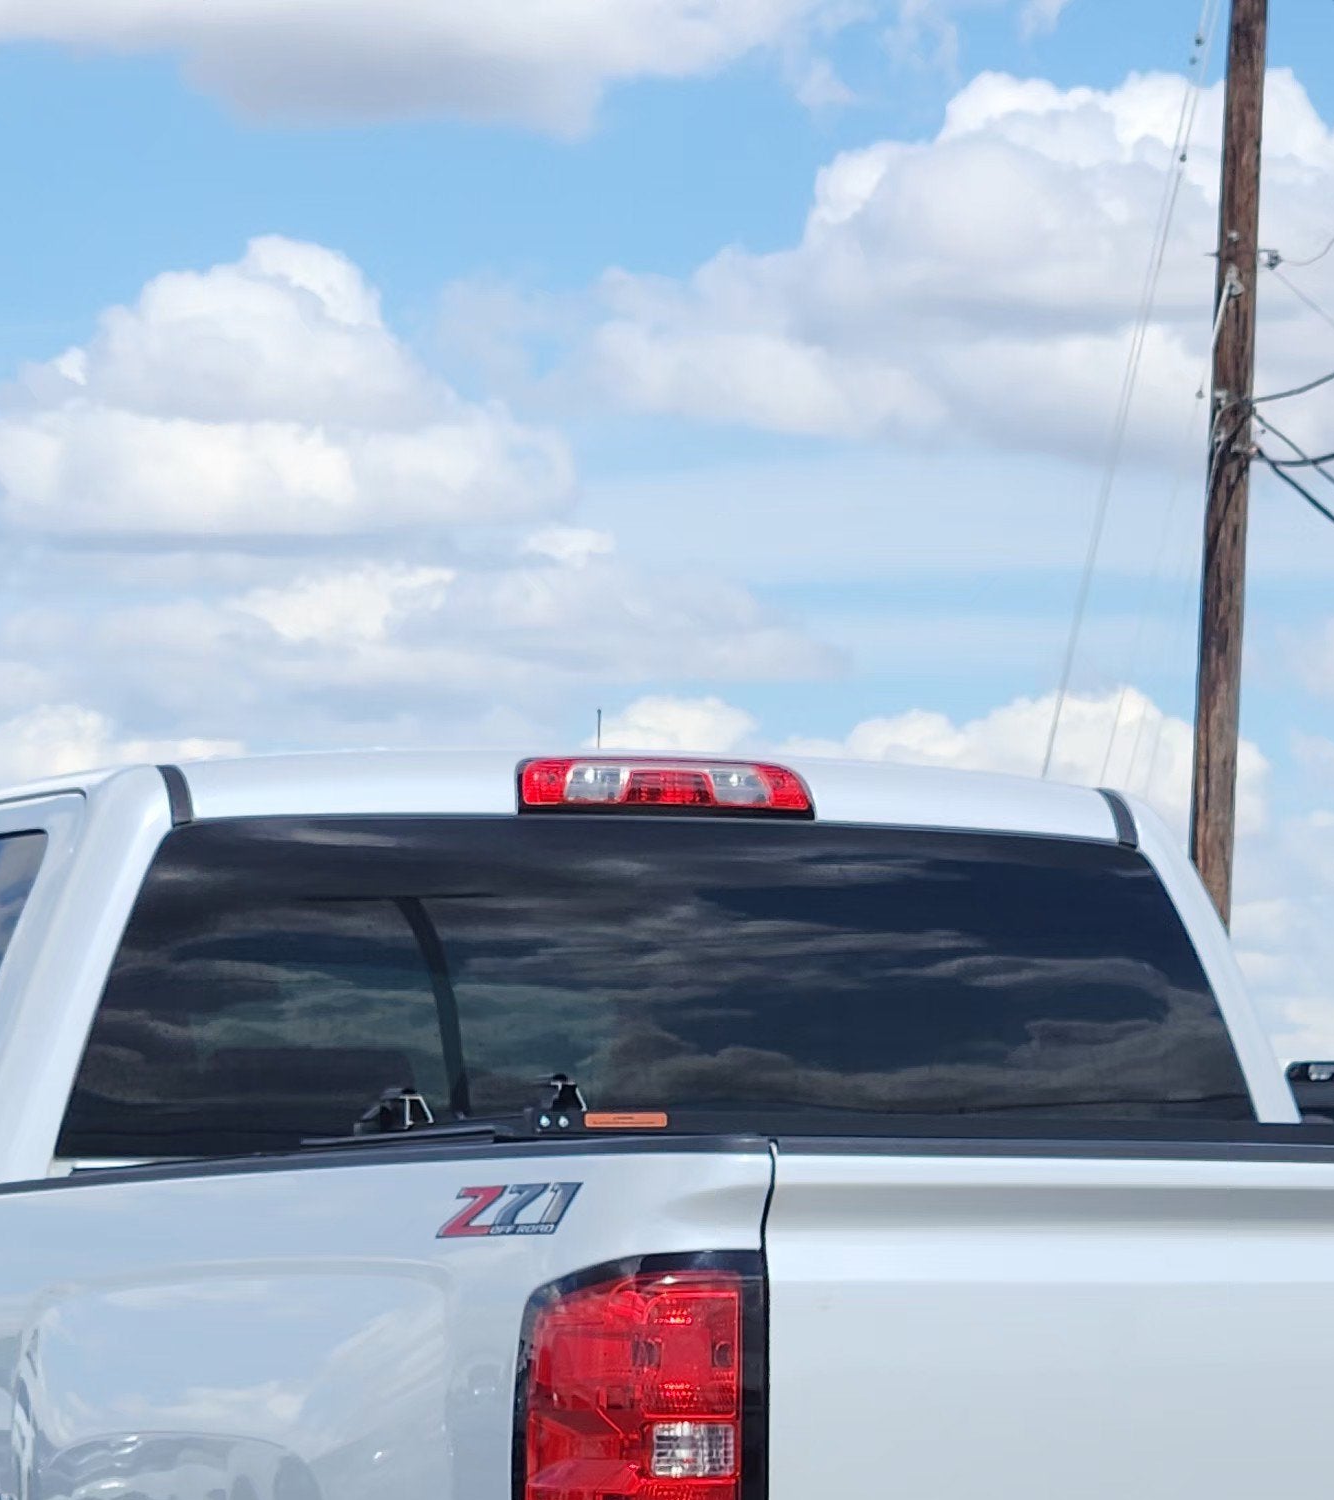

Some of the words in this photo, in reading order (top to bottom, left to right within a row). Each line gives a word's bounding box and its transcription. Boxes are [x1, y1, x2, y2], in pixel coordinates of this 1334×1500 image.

[436, 1182, 583, 1239] Z71
[490, 1225, 515, 1235] OFF
[516, 1224, 555, 1234] ROAD
